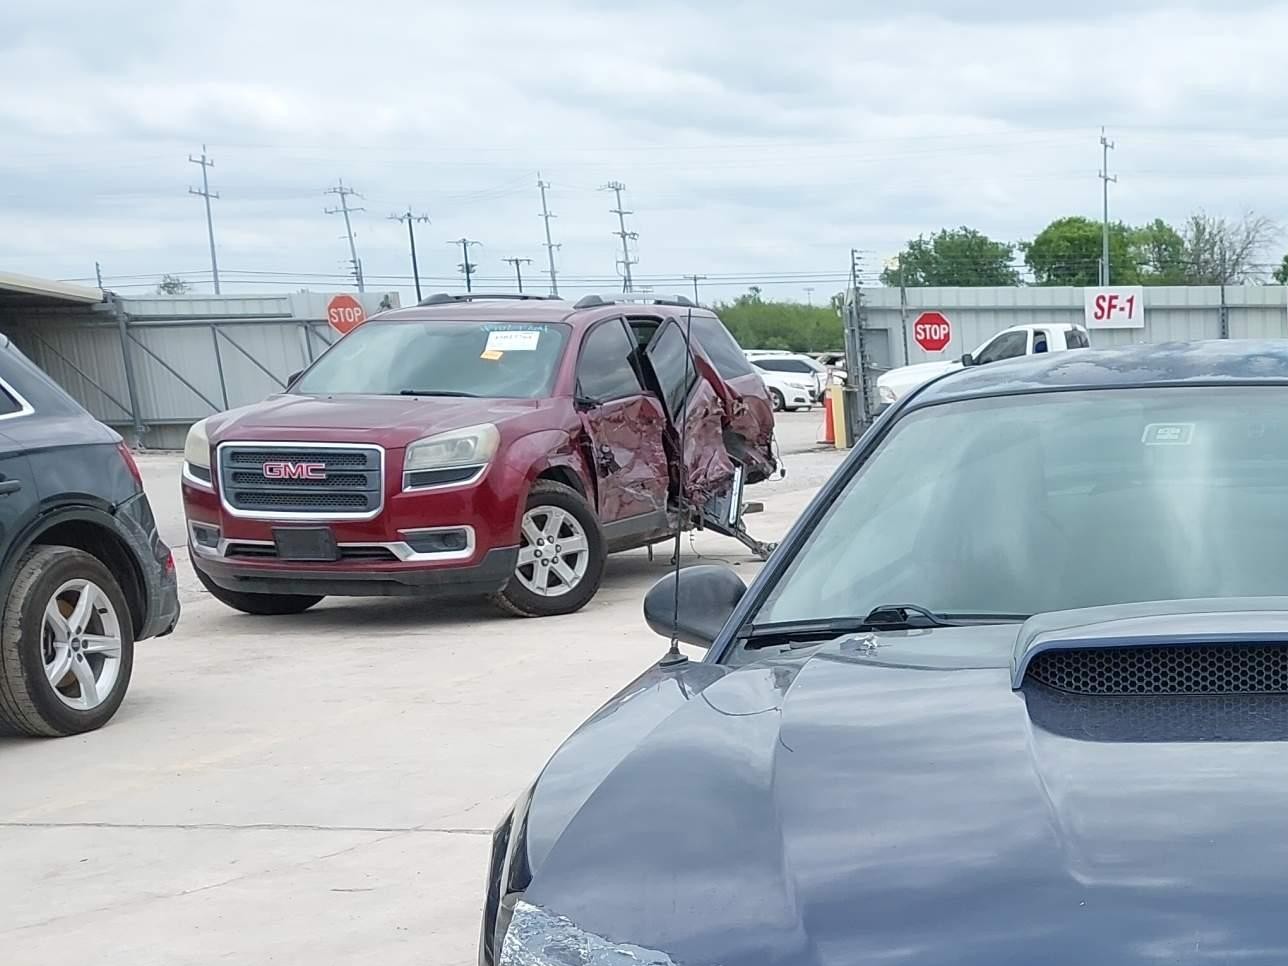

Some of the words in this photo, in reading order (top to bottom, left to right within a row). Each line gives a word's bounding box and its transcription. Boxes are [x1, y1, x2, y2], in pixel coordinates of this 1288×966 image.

[330, 307, 362, 322] STOP
[1094, 294, 1135, 320] SF-1
[916, 324, 949, 340] STOP
[263, 462, 326, 479] GMC
